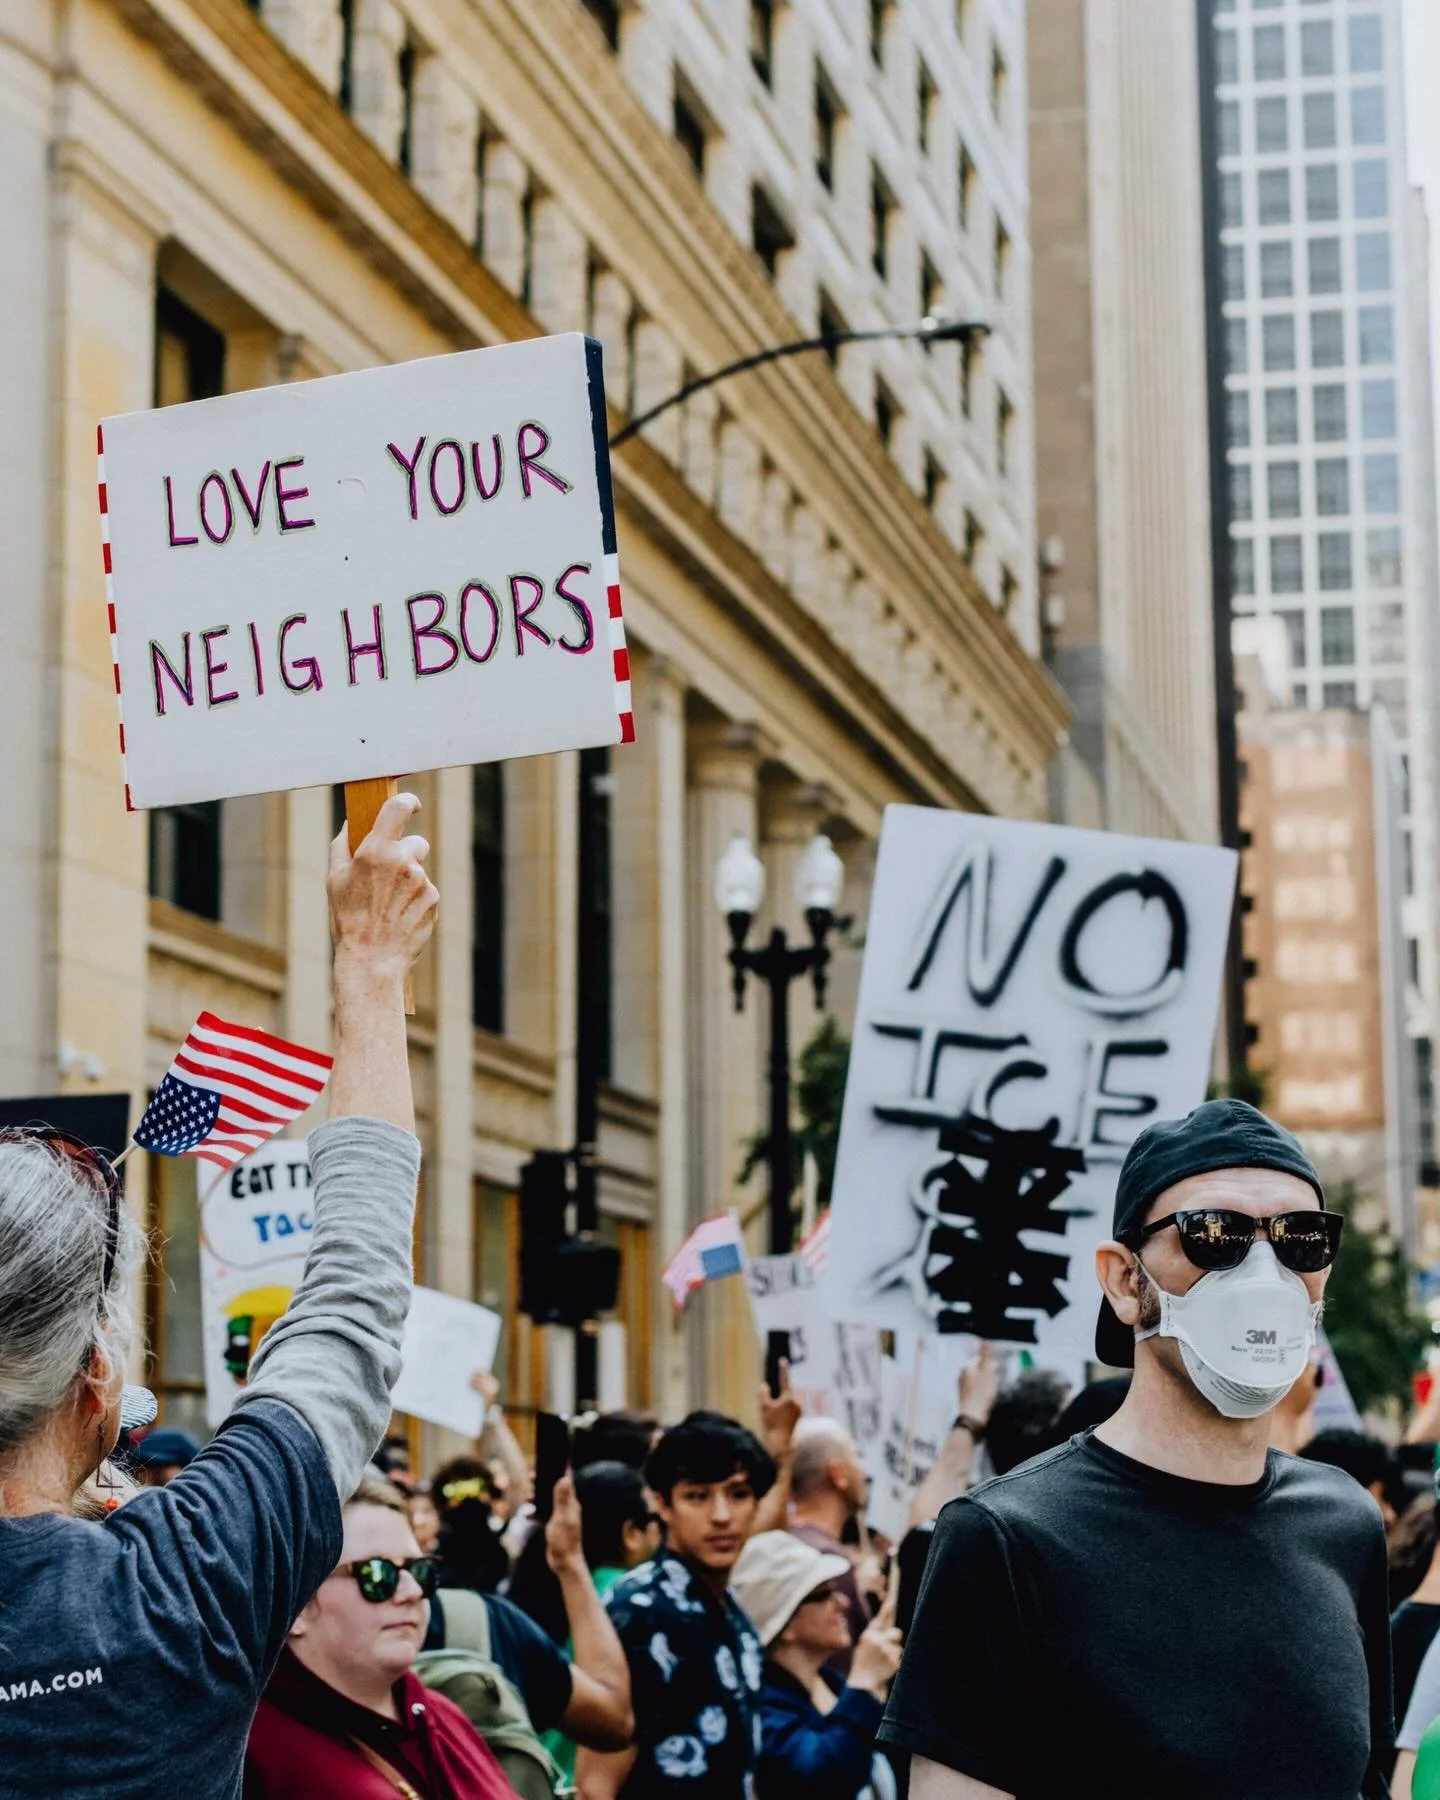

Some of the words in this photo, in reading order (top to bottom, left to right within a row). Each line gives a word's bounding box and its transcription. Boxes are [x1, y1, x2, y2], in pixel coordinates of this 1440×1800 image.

[163, 455, 316, 547] LOVE
[385, 419, 575, 520] YOUR
[148, 561, 597, 716] NEIGHBORS
[906, 840, 1190, 1018] NO
[870, 1021, 1170, 1163] ICE
[231, 1163, 276, 1199] EAT
[1245, 1329, 1277, 1345] 3M
[0, 1667, 103, 1702] AMA.COM
